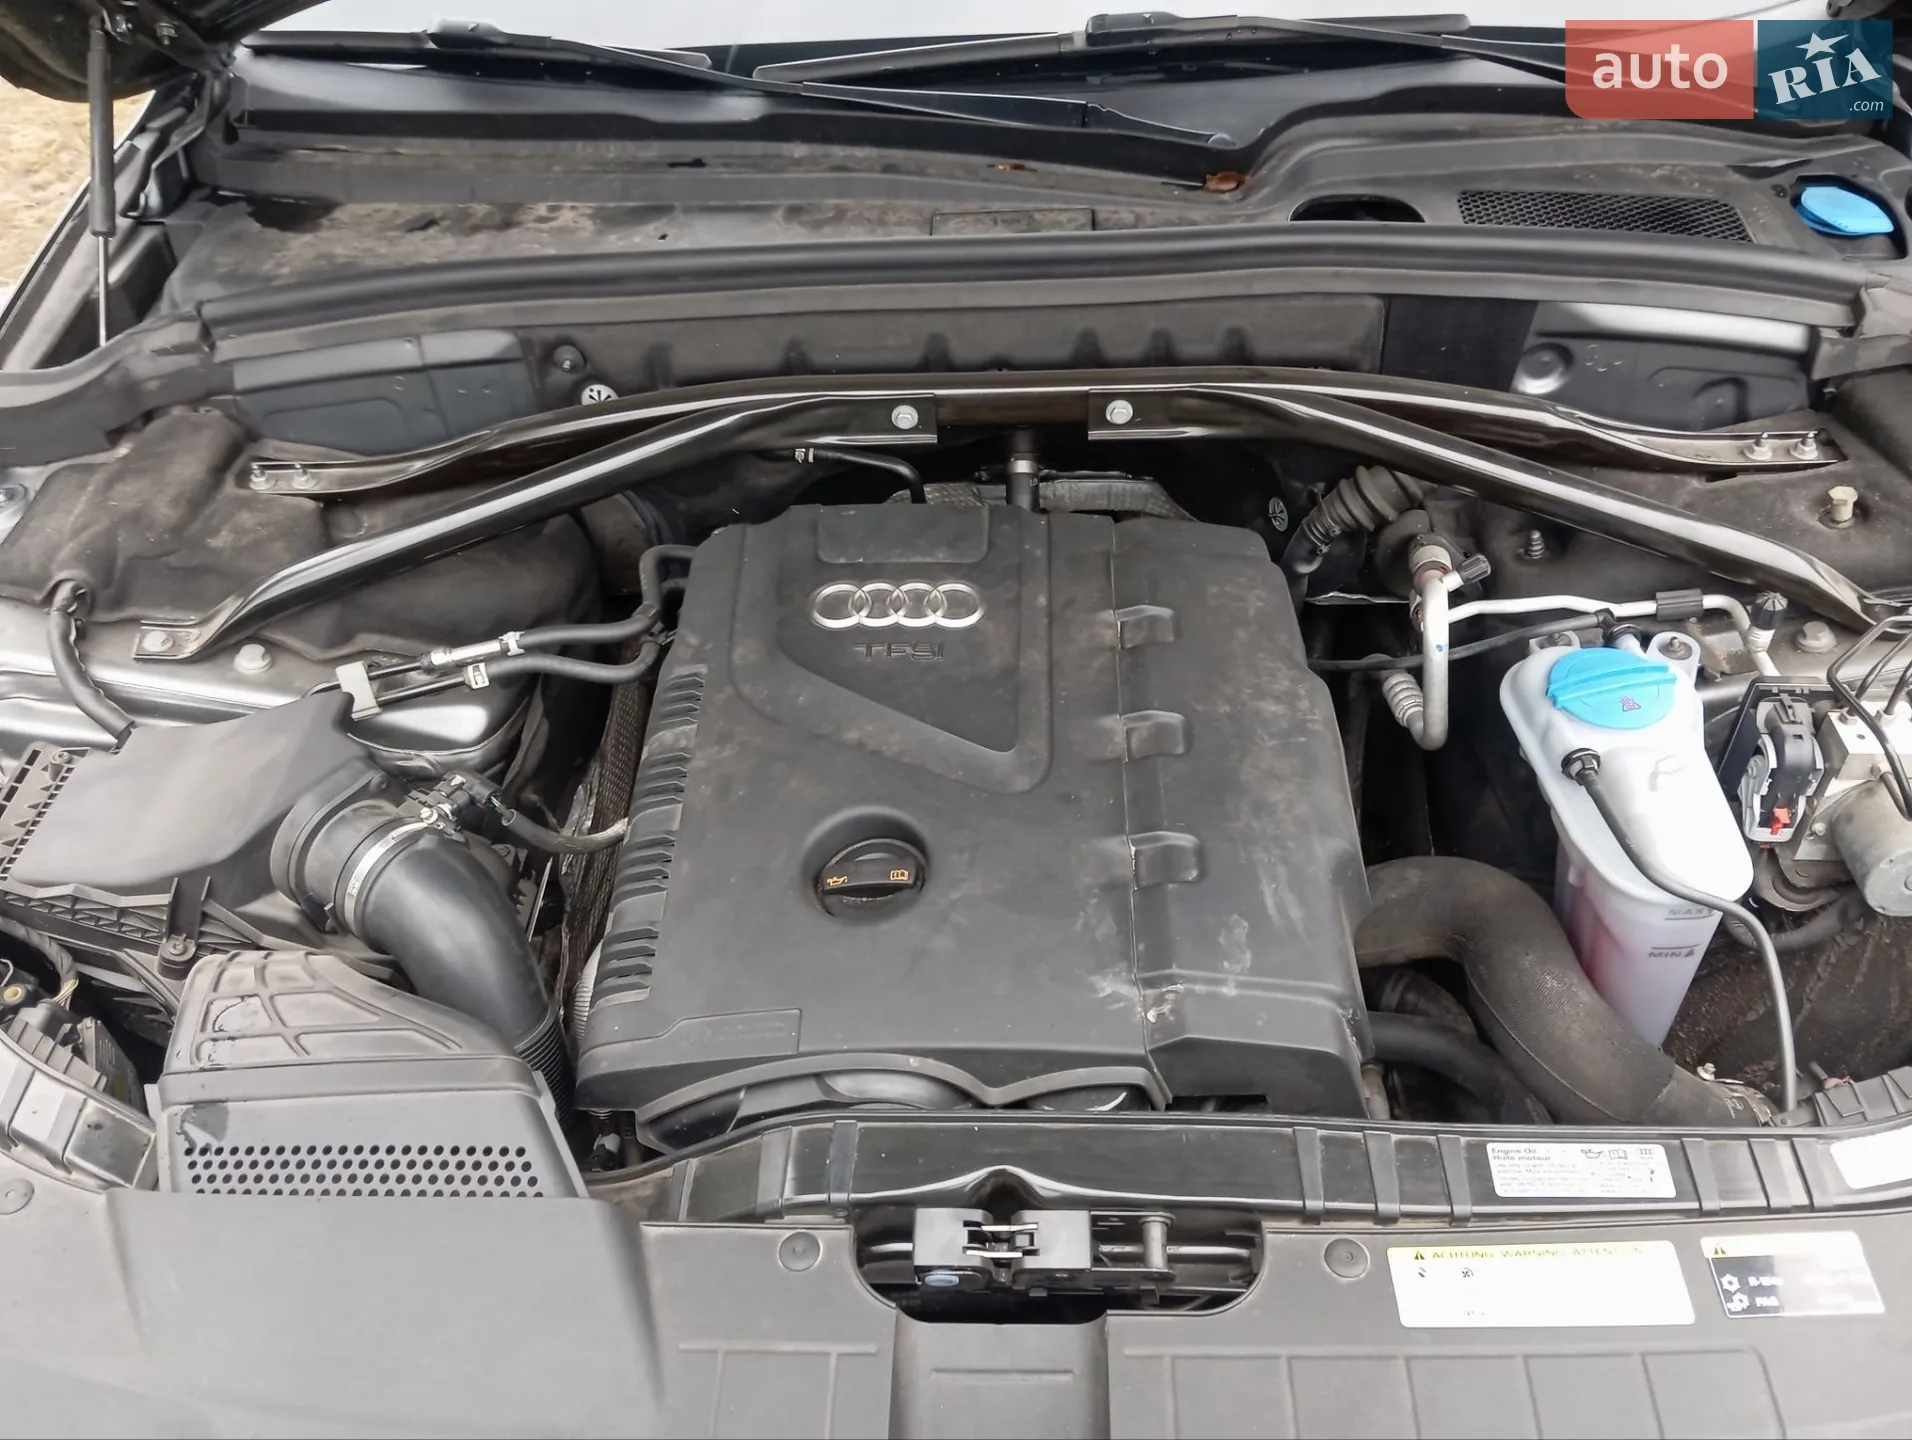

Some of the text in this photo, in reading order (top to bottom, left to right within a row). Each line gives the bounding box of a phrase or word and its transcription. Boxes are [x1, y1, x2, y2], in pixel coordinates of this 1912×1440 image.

[854, 643, 944, 661] TFSI
[1648, 951, 1683, 959] MIN
[1491, 1147, 1537, 1156] Engine Oil
